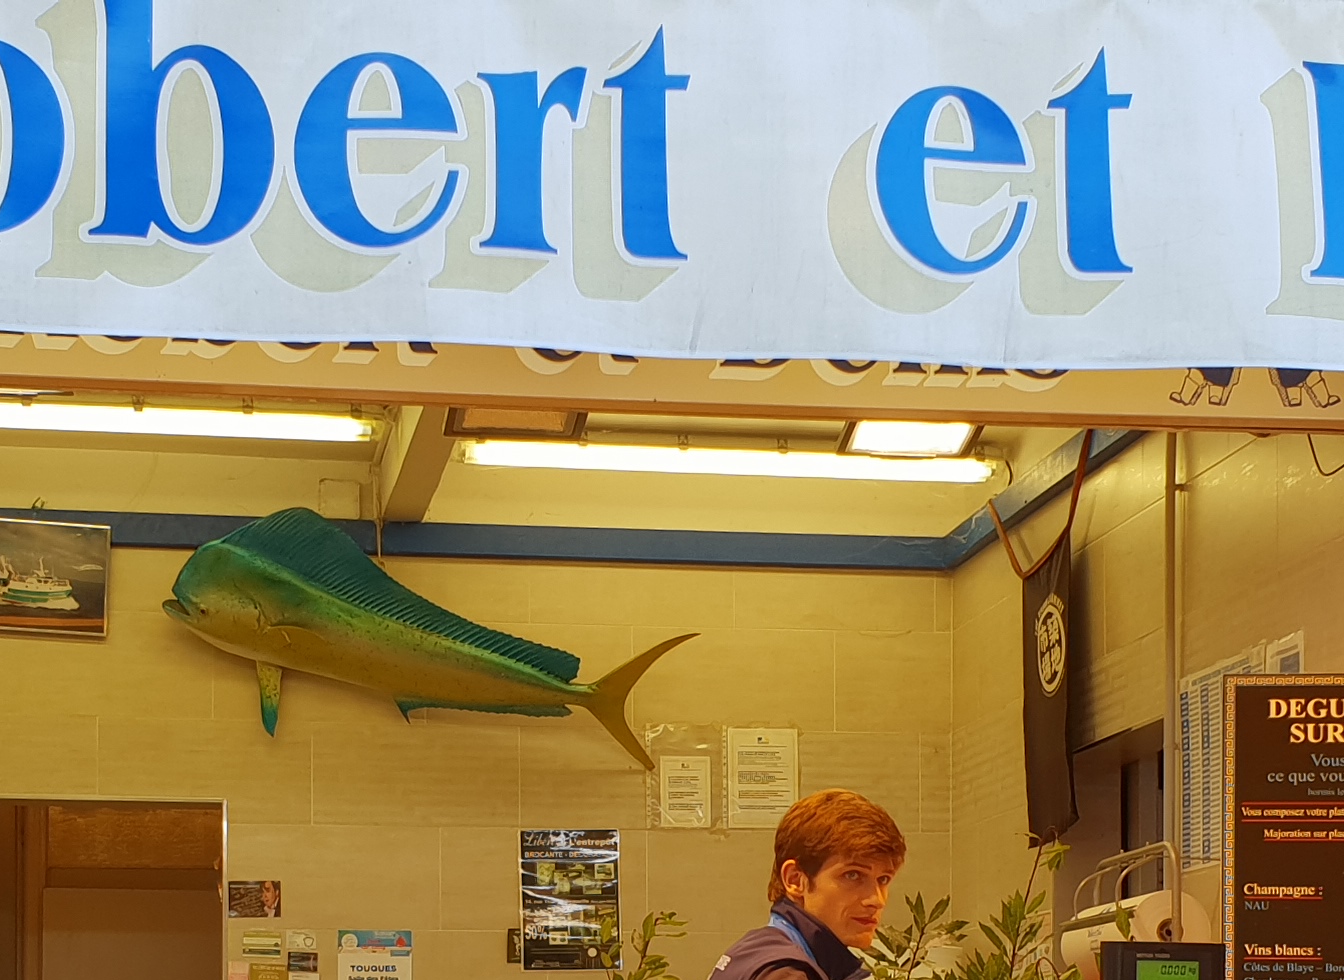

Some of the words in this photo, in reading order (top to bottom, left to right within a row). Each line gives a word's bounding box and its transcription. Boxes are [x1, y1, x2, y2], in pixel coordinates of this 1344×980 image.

[874, 46, 1133, 275] et
[1268, 773, 1284, 782] ce
[1289, 773, 1315, 785] que
[1244, 883, 1315, 897] Champagne
[1245, 901, 1269, 910] NAU
[1245, 944, 1272, 955] Vins
[1275, 944, 1313, 955] blancs
[350, 965, 397, 973] TOUQUES
[1244, 962, 1270, 971] Côtes
[1273, 963, 1284, 971] de
[1287, 963, 1314, 974] Blaye
